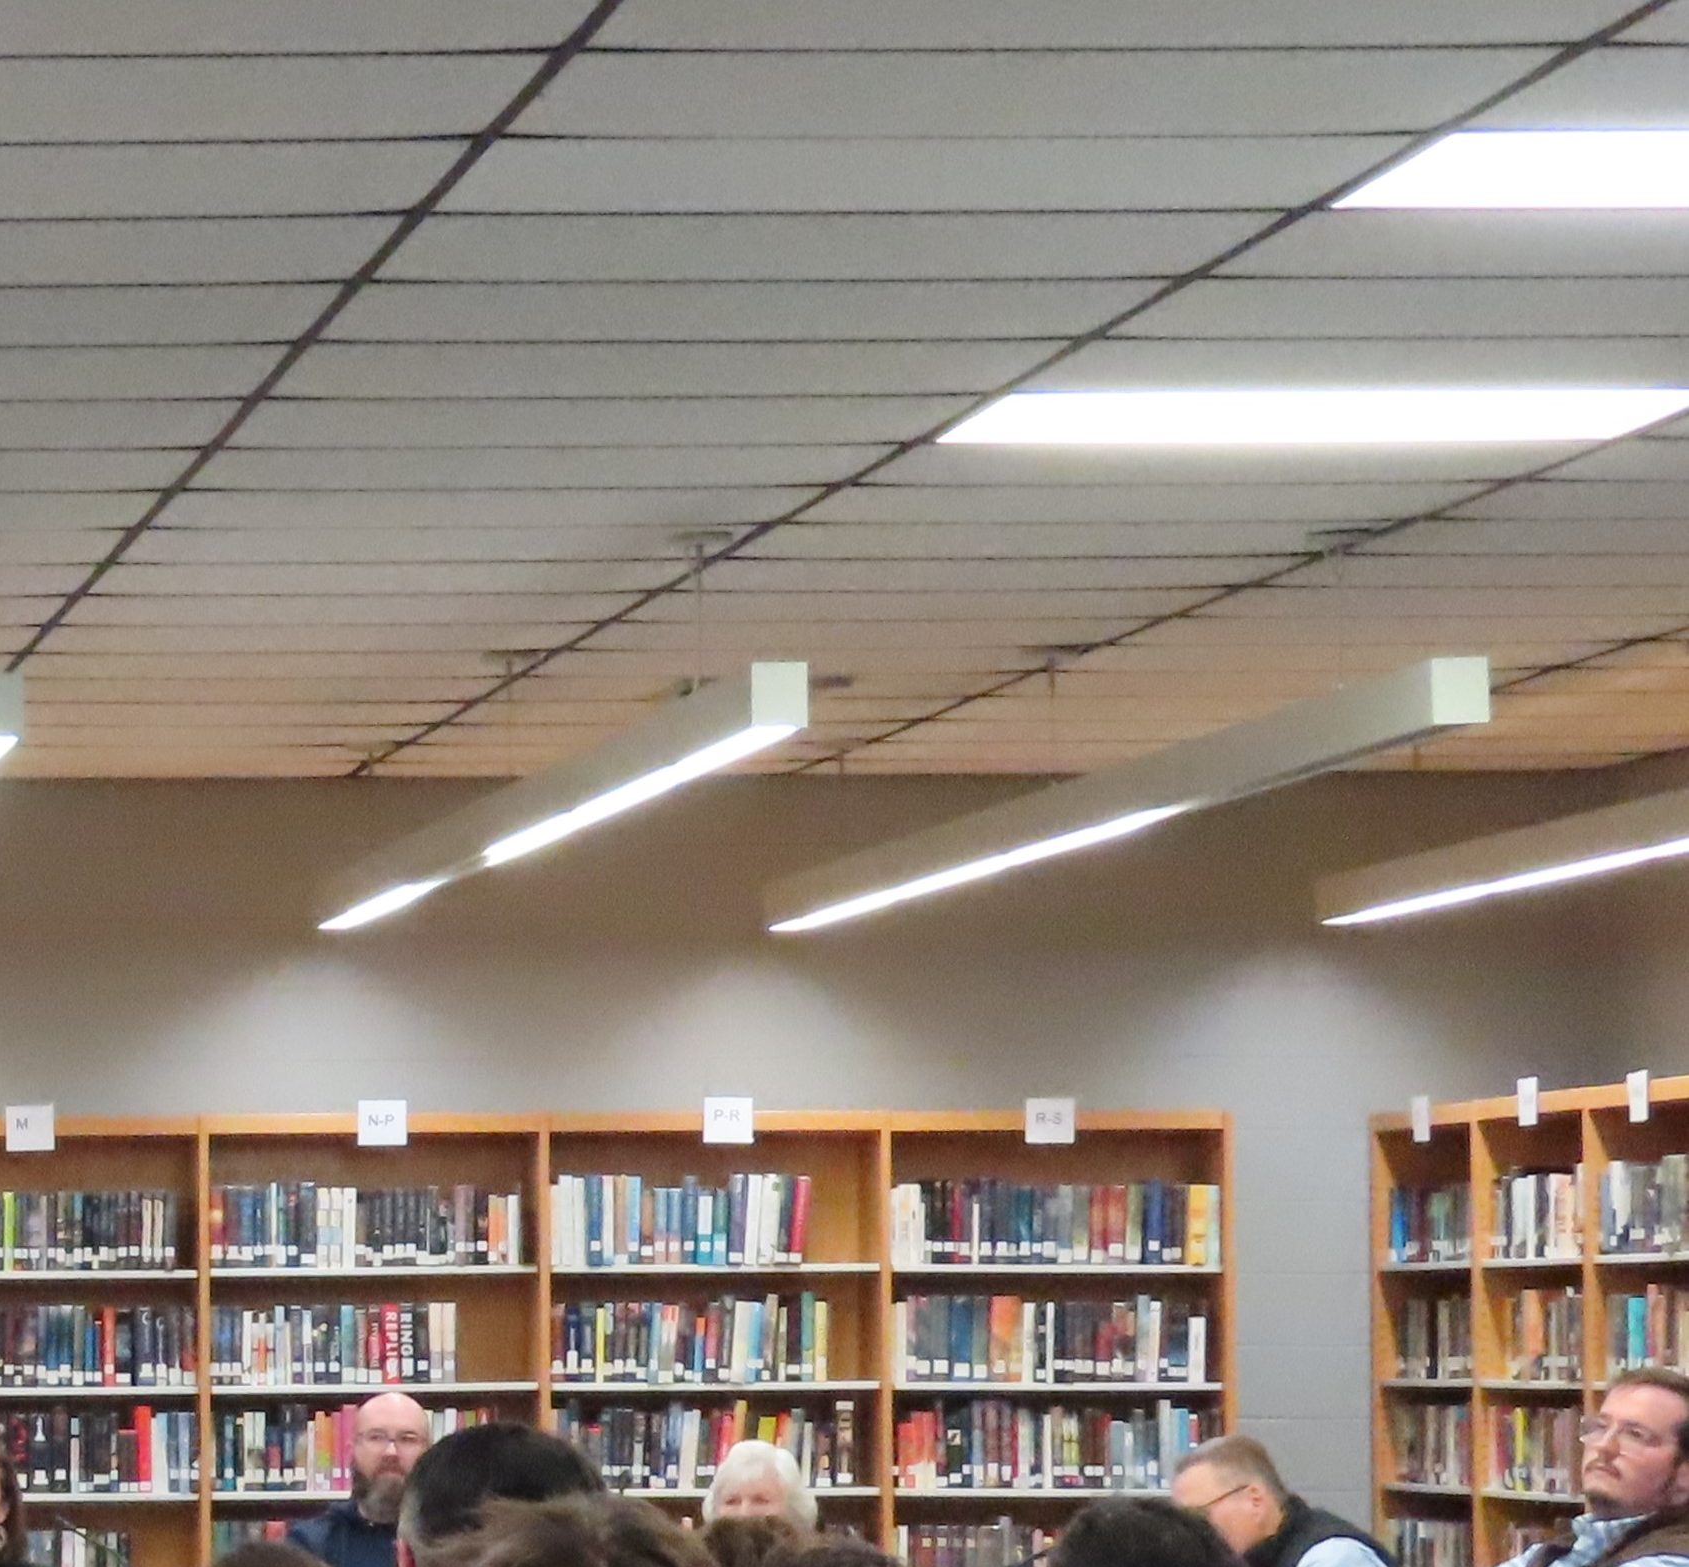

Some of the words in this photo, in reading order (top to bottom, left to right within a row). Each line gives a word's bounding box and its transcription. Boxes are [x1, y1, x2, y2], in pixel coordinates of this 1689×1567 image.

[368, 1114, 395, 1126] N-P
[713, 1109, 740, 1121] P-R
[16, 1118, 28, 1129] M
